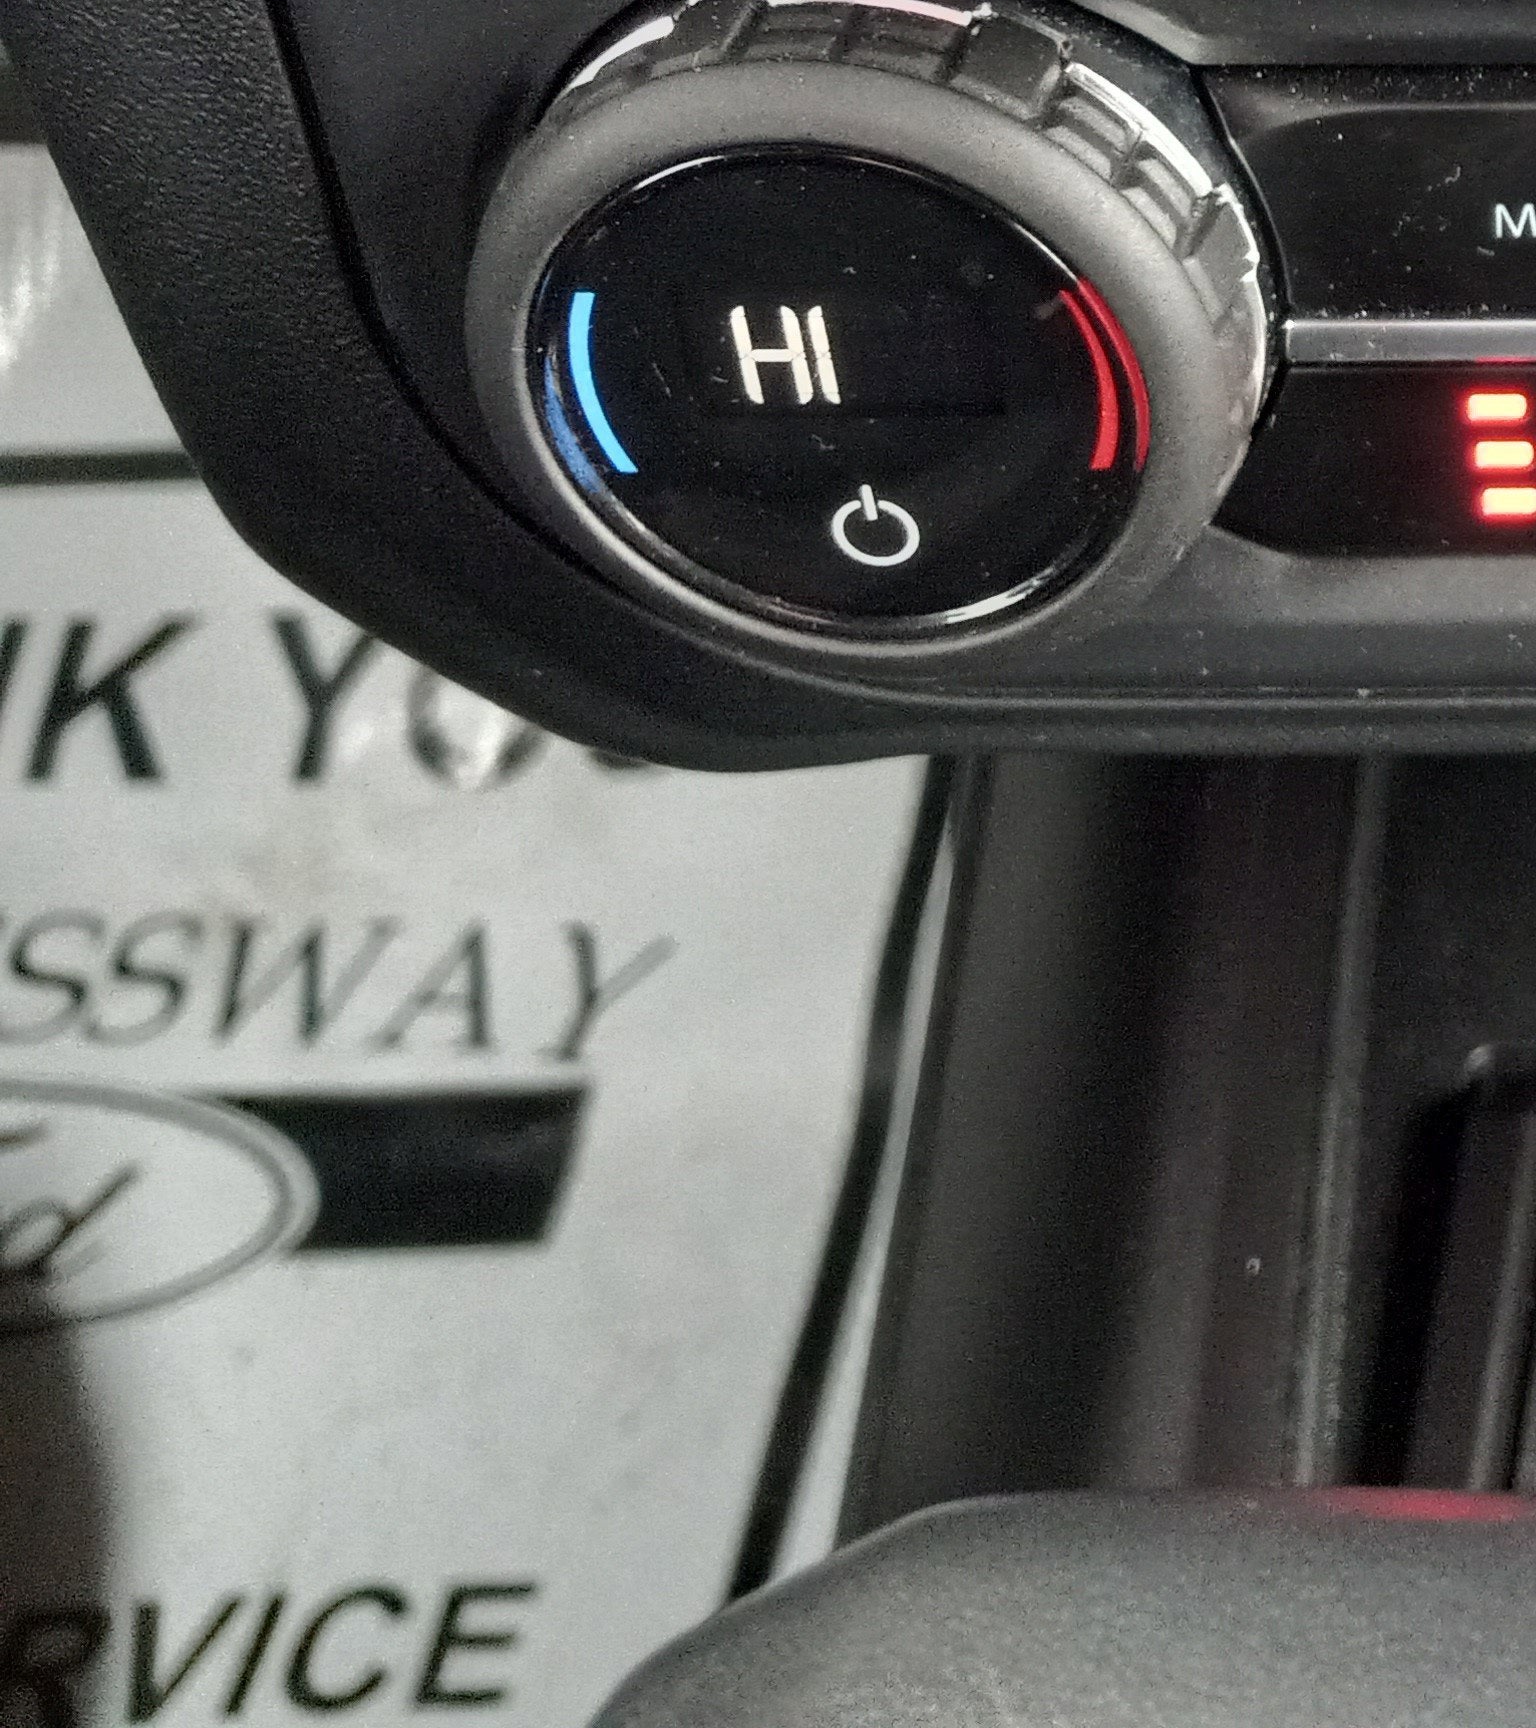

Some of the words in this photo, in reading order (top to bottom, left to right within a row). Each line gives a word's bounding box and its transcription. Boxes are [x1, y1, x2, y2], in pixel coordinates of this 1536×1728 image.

[730, 306, 840, 404] HI
[0, 612, 195, 786] K
[266, 612, 668, 790] YO
